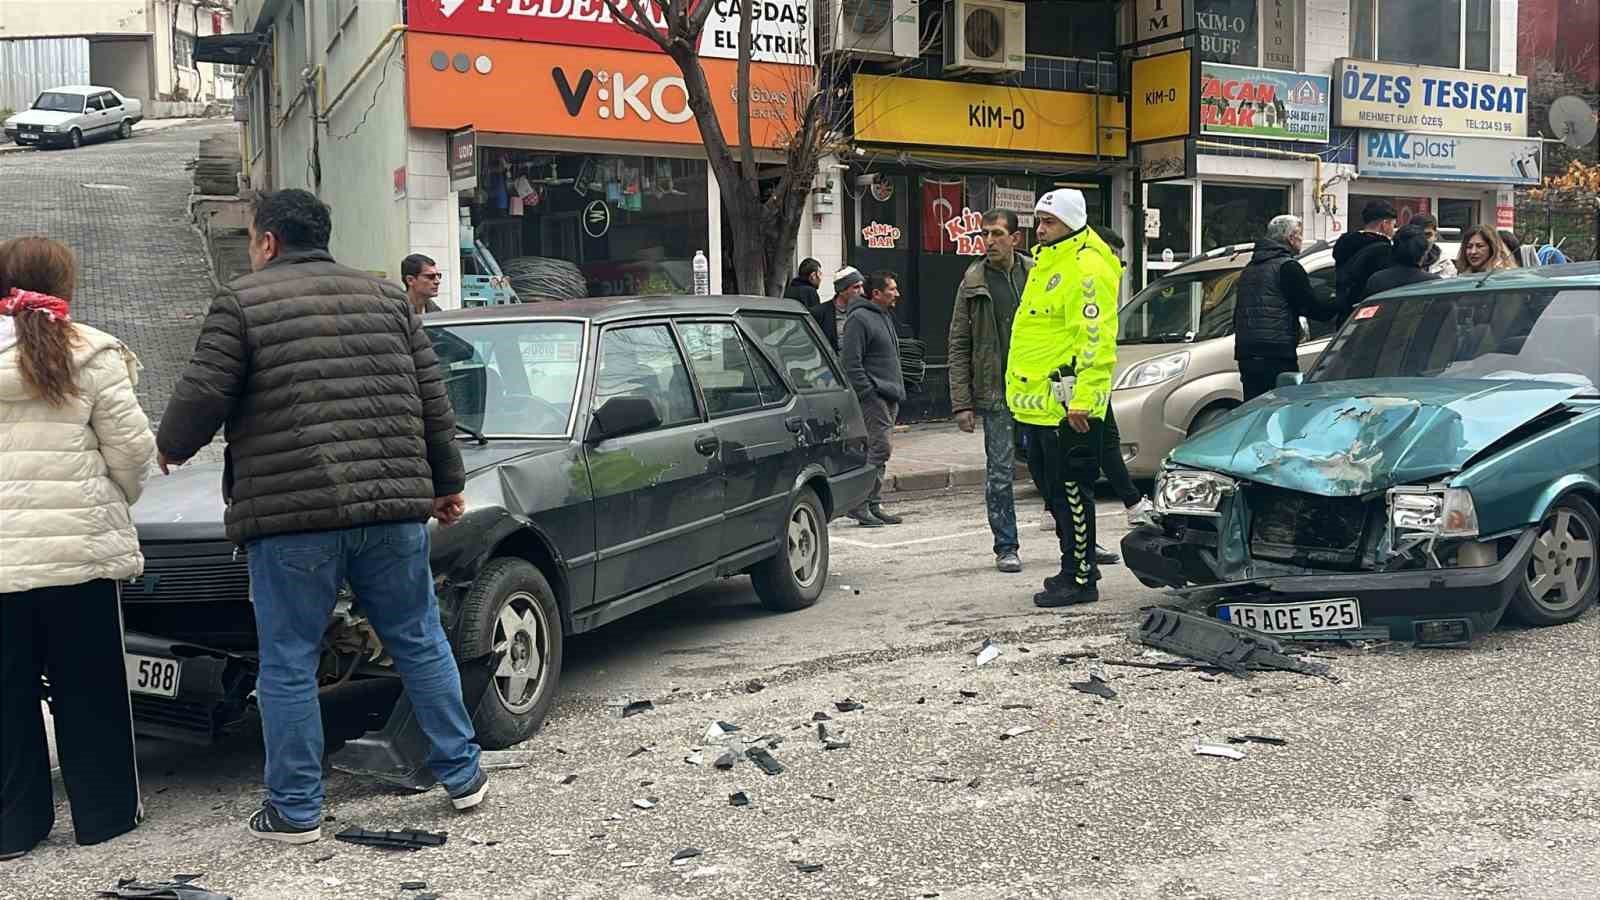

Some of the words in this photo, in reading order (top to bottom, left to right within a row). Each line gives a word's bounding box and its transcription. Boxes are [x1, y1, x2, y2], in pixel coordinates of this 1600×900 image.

[715, 30, 808, 55] ELKTRİK
[1343, 65, 1411, 108] ÖZEŞ
[968, 99, 1025, 130] KİM-O
[1359, 111, 1395, 124] MEHMET
[1397, 113, 1418, 125] FUAT
[1421, 114, 1443, 128] ÖZEŞ
[1367, 132, 1410, 159] PAK
[1413, 137, 1457, 160] plast
[868, 236, 895, 248] BAR
[1234, 608, 1257, 629] 15
[1263, 607, 1303, 631] ACE
[1309, 603, 1354, 628] 525
[138, 660, 175, 691] 588
